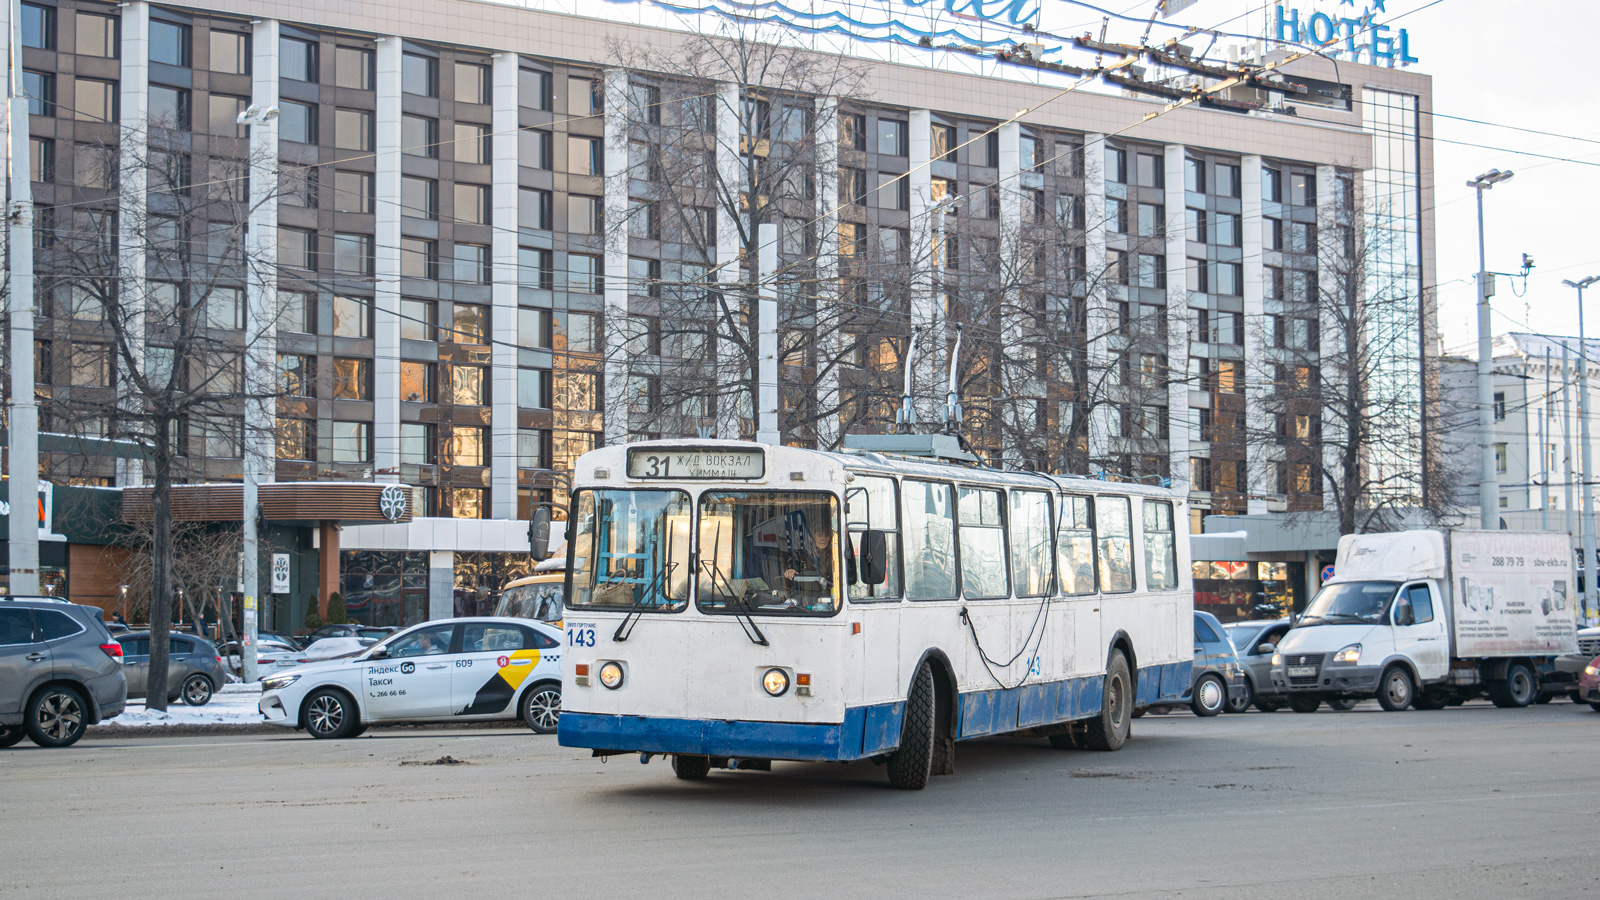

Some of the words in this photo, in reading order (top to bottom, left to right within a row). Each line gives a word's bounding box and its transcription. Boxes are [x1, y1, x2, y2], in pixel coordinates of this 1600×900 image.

[1276, 5, 1419, 65] HOTEL
[676, 454, 700, 466] Ж/Д
[706, 455, 751, 466] ВОКЗАЛ
[646, 456, 671, 477] 31
[1492, 556, 1504, 567] 288
[1506, 556, 1515, 567] 79
[1516, 556, 1525, 567] 79
[1534, 556, 1567, 567] sbv-ekb.ru
[567, 628, 596, 648] 143
[368, 666, 399, 675] Яндекс
[401, 662, 415, 673] Go
[455, 659, 473, 668] 609
[368, 677, 393, 687] Такси
[376, 690, 388, 698] 266
